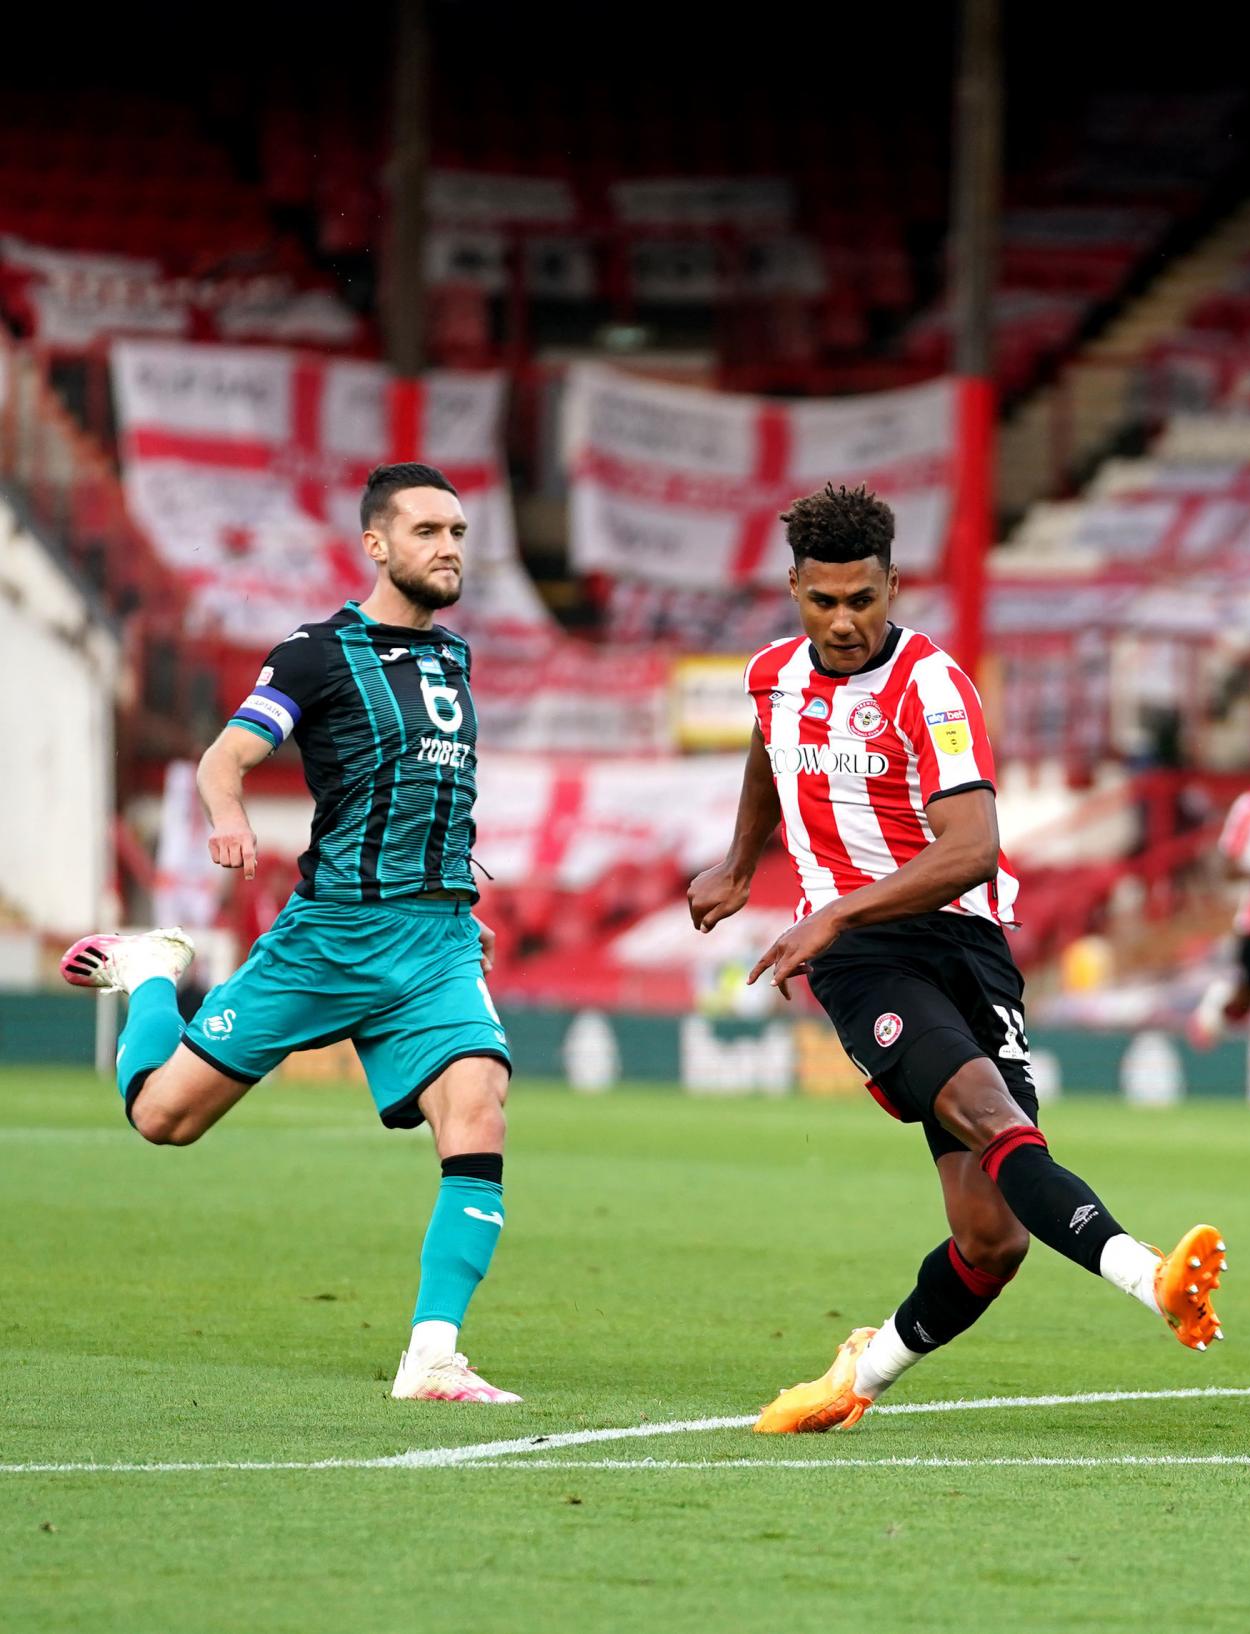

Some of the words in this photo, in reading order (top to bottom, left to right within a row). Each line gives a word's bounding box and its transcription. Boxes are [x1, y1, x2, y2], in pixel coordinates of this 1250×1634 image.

[928, 713, 945, 724] sky
[947, 710, 965, 720] bet
[417, 736, 470, 769] YOBET
